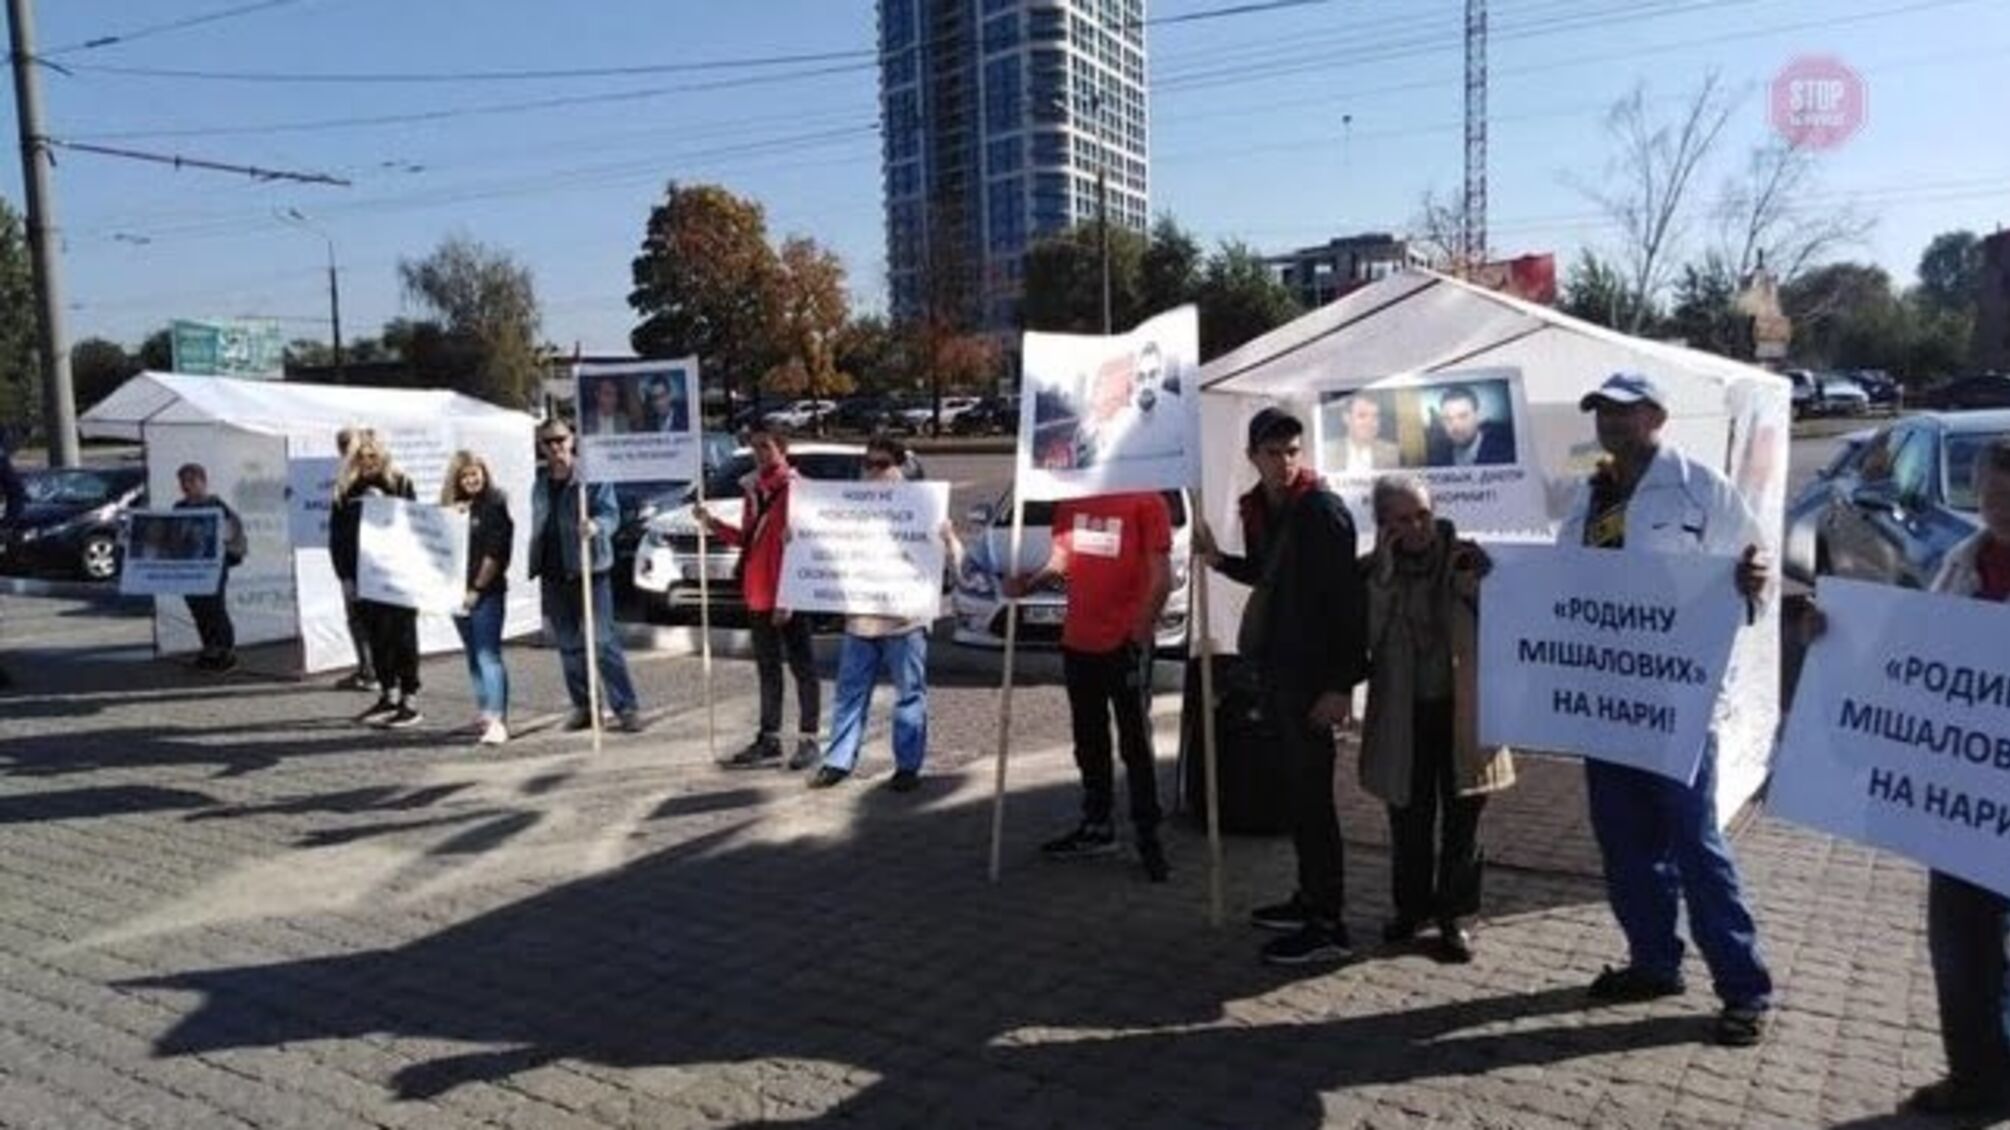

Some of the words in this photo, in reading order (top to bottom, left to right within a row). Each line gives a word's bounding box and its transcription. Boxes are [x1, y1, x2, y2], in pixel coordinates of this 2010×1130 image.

[1553, 598, 1677, 633] «РОДИНУ
[1517, 639, 1707, 685] МІШАЛОВИХ»
[1553, 690, 1591, 718] НА
[1597, 697, 1677, 733] НАРИ!
[1868, 767, 1915, 808] НА
